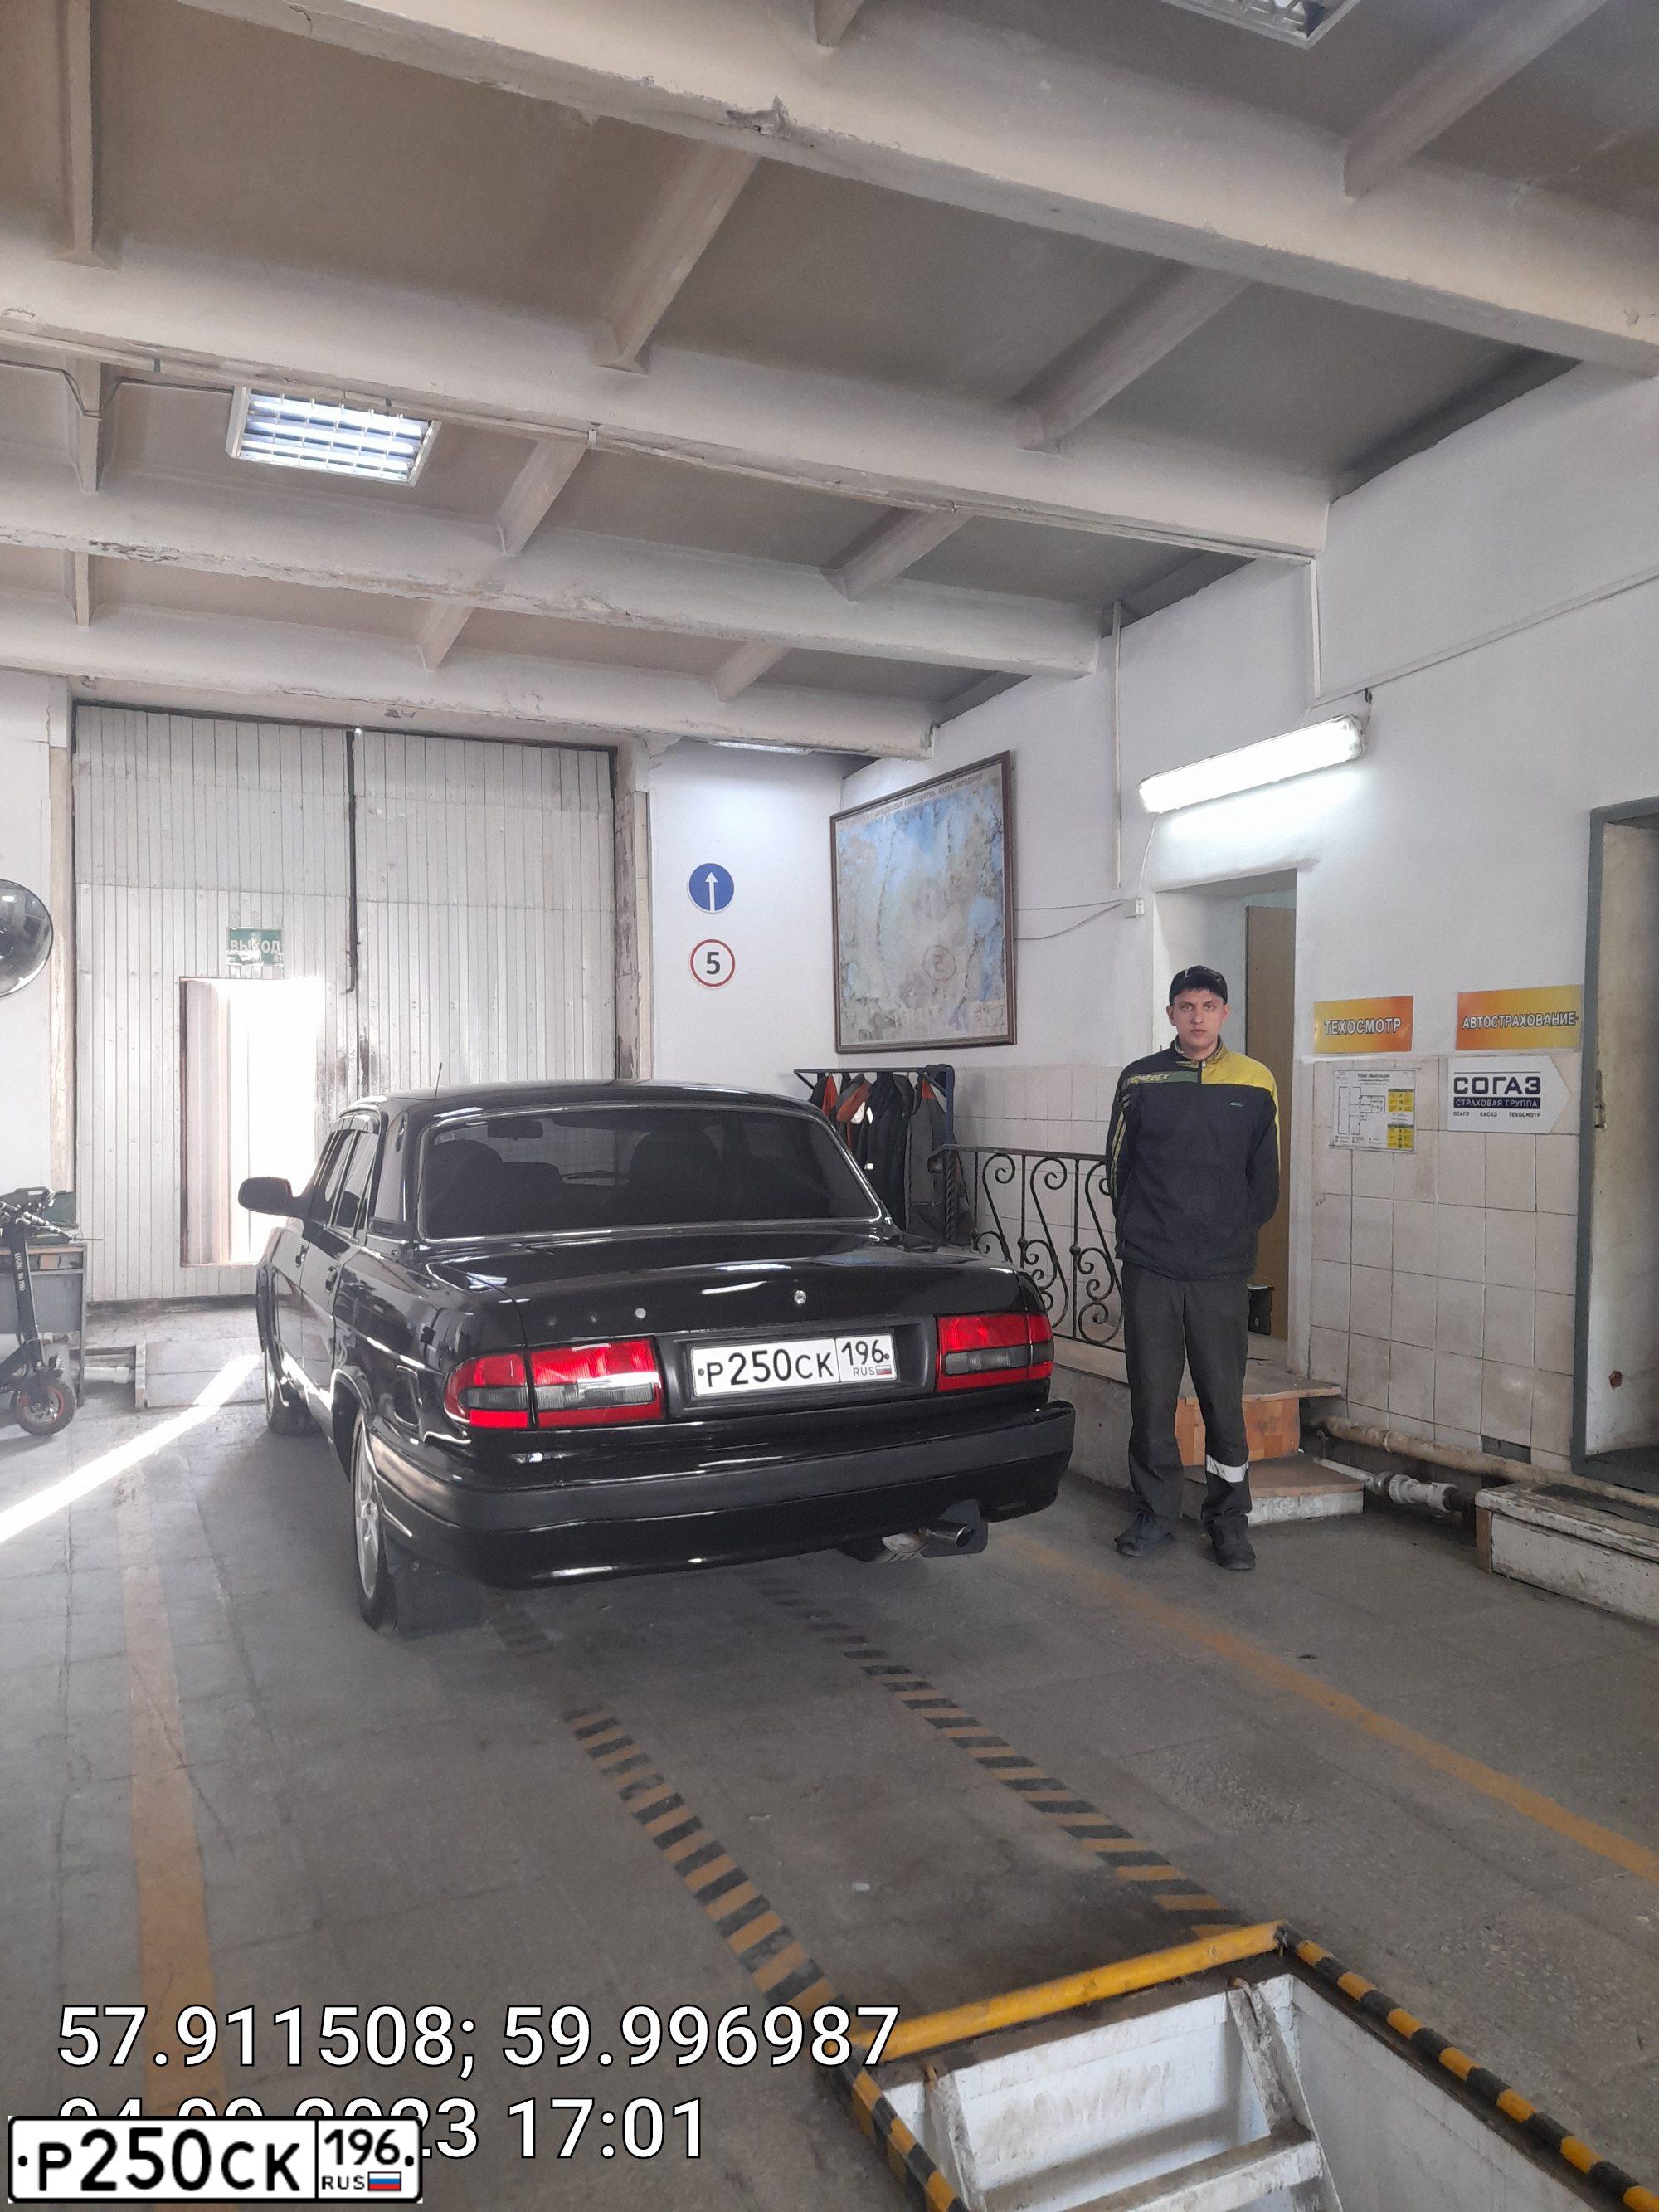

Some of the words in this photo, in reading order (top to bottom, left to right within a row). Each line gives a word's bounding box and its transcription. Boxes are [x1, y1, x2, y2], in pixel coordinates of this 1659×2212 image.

[706, 951, 721, 975] 5
[1324, 1017, 1401, 1035] ТЕХОСМОТР
[1462, 1011, 1576, 1030] АВТОСТРАХОВАНИЕ
[1453, 1076, 1541, 1094] СОГАЗ
[1455, 1099, 1503, 1107] СТРАХОВАЯ
[1505, 1099, 1538, 1108] ГРУППА
[841, 1339, 884, 1366] 196
[853, 1367, 875, 1376] RUS
